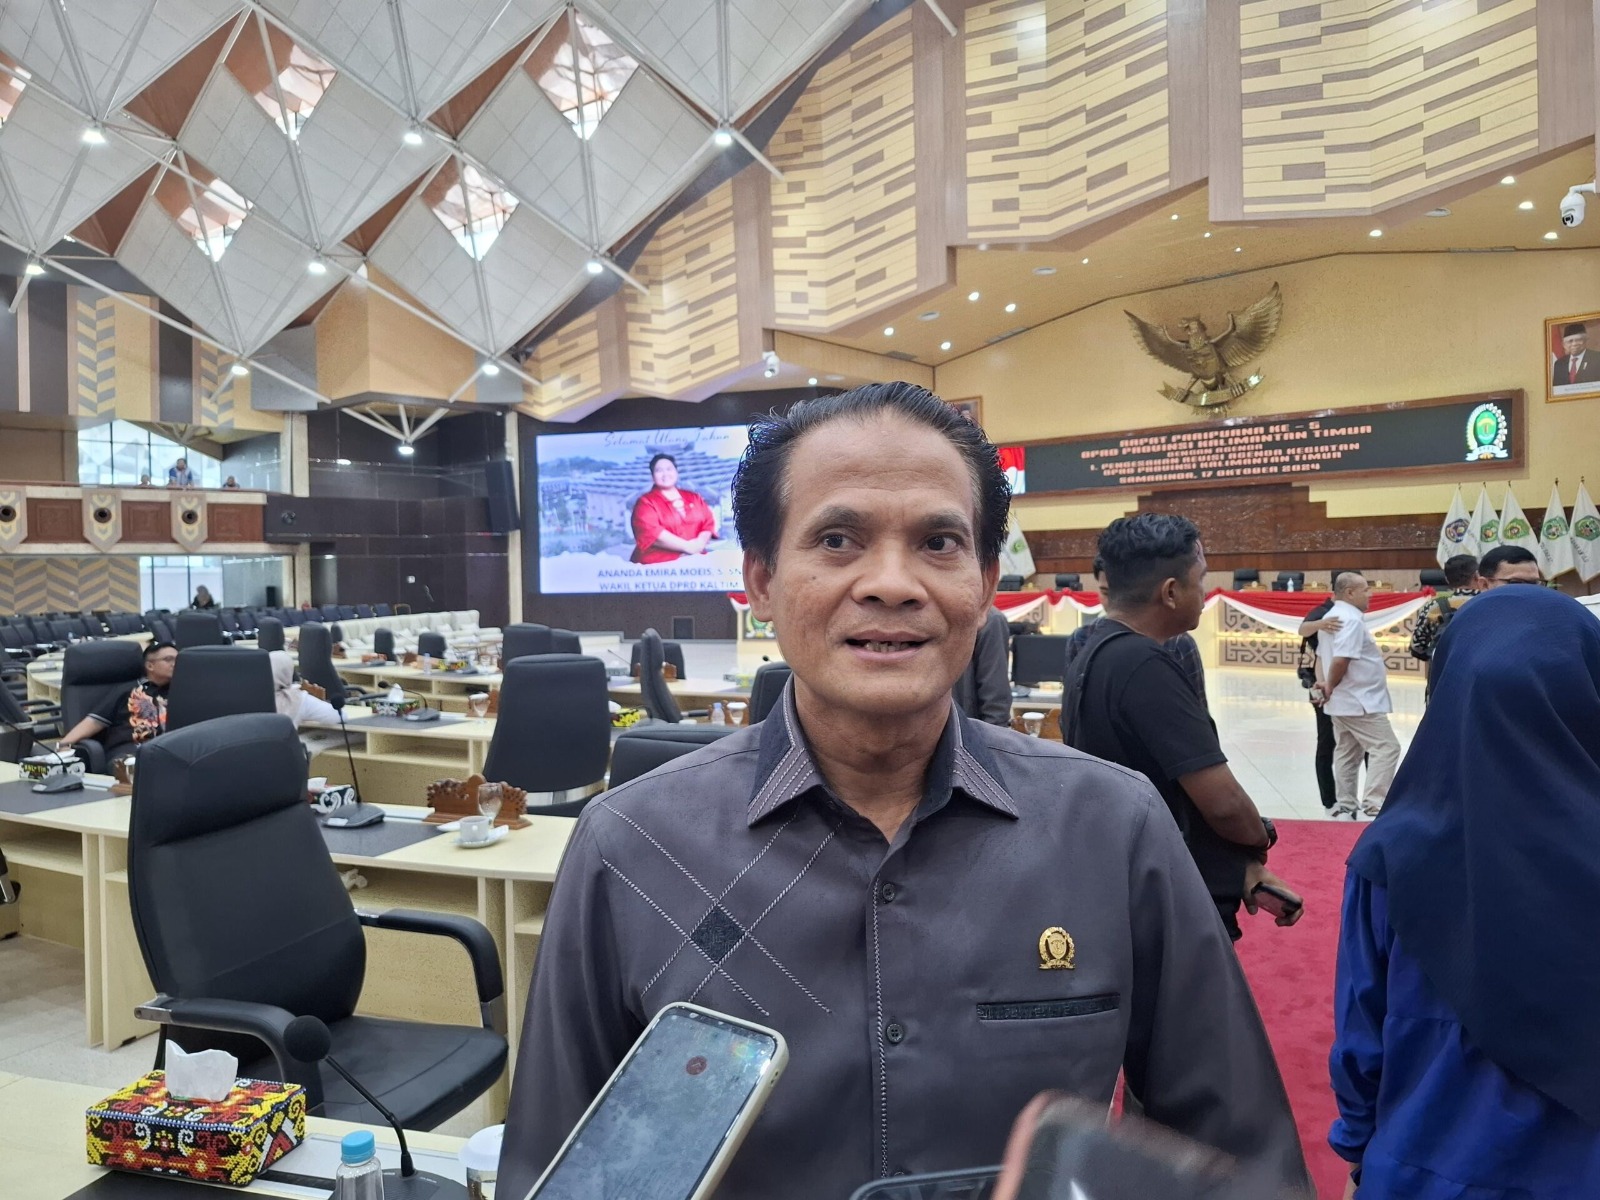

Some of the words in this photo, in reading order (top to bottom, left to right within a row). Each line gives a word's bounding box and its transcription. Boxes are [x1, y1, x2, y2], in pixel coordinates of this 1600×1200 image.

[603, 432, 650, 447] Selamat
[654, 430, 689, 446] Ulang
[695, 428, 730, 442] Tahun
[1081, 448, 1119, 459] DPRD
[1122, 441, 1194, 455] PROVINSI
[1197, 431, 1307, 448] KALIMANTAN
[1313, 425, 1372, 438] TIMUR
[1119, 436, 1168, 447] RAPAT
[1171, 427, 1265, 442] PARIPURNA
[1269, 424, 1290, 434] KE
[1101, 457, 1180, 470] PENGESAHAN
[1182, 453, 1225, 463] REVISI
[1228, 449, 1283, 460] AGENDA
[1286, 442, 1360, 456] KEGIATAN
[1167, 448, 1213, 458] DENGAN
[1215, 443, 1263, 454] AGENDA
[1103, 467, 1135, 476] DPRD
[1137, 462, 1197, 474] PROVINSI
[1199, 455, 1290, 469] KALIMANTAN
[1294, 451, 1342, 462] TIMUR
[1201, 470, 1213, 478] 17
[1216, 465, 1278, 477] OKTOBER
[1281, 463, 1321, 473] 2024
[597, 568, 643, 578] ANANDA
[645, 567, 677, 577] EMIRA
[599, 581, 631, 591] WAKIL
[635, 580, 668, 590] KETUA
[669, 580, 697, 590] DPRD
